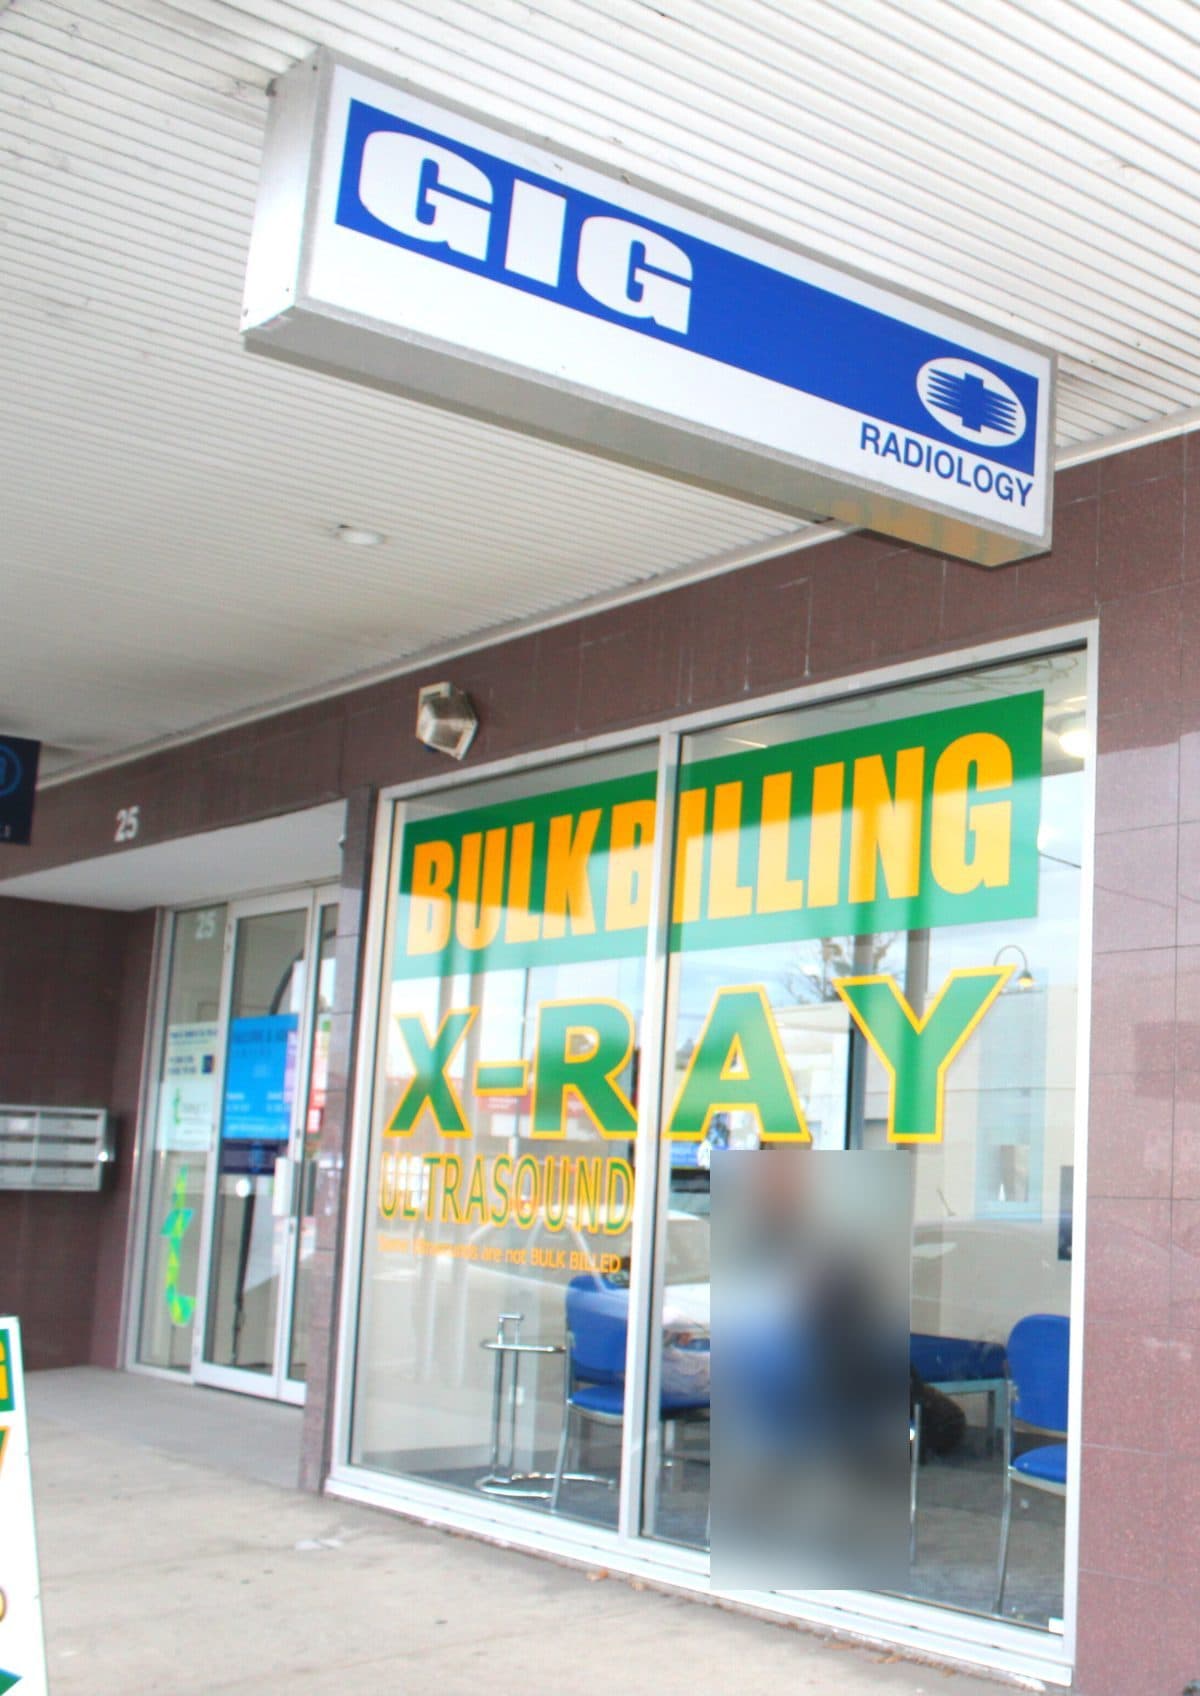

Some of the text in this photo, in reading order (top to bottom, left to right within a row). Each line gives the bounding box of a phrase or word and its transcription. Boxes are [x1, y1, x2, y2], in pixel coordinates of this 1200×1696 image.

[358, 130, 694, 334] GIG
[859, 421, 1034, 508] RADIOLOGY
[114, 805, 140, 843] 25
[195, 911, 217, 940] 25
[383, 964, 1018, 1143] X-RAY
[378, 1152, 636, 1236] ULTRASOUND
[506, 1247, 526, 1264] not
[531, 1248, 566, 1269] BULK
[569, 1250, 622, 1274] BILLED
